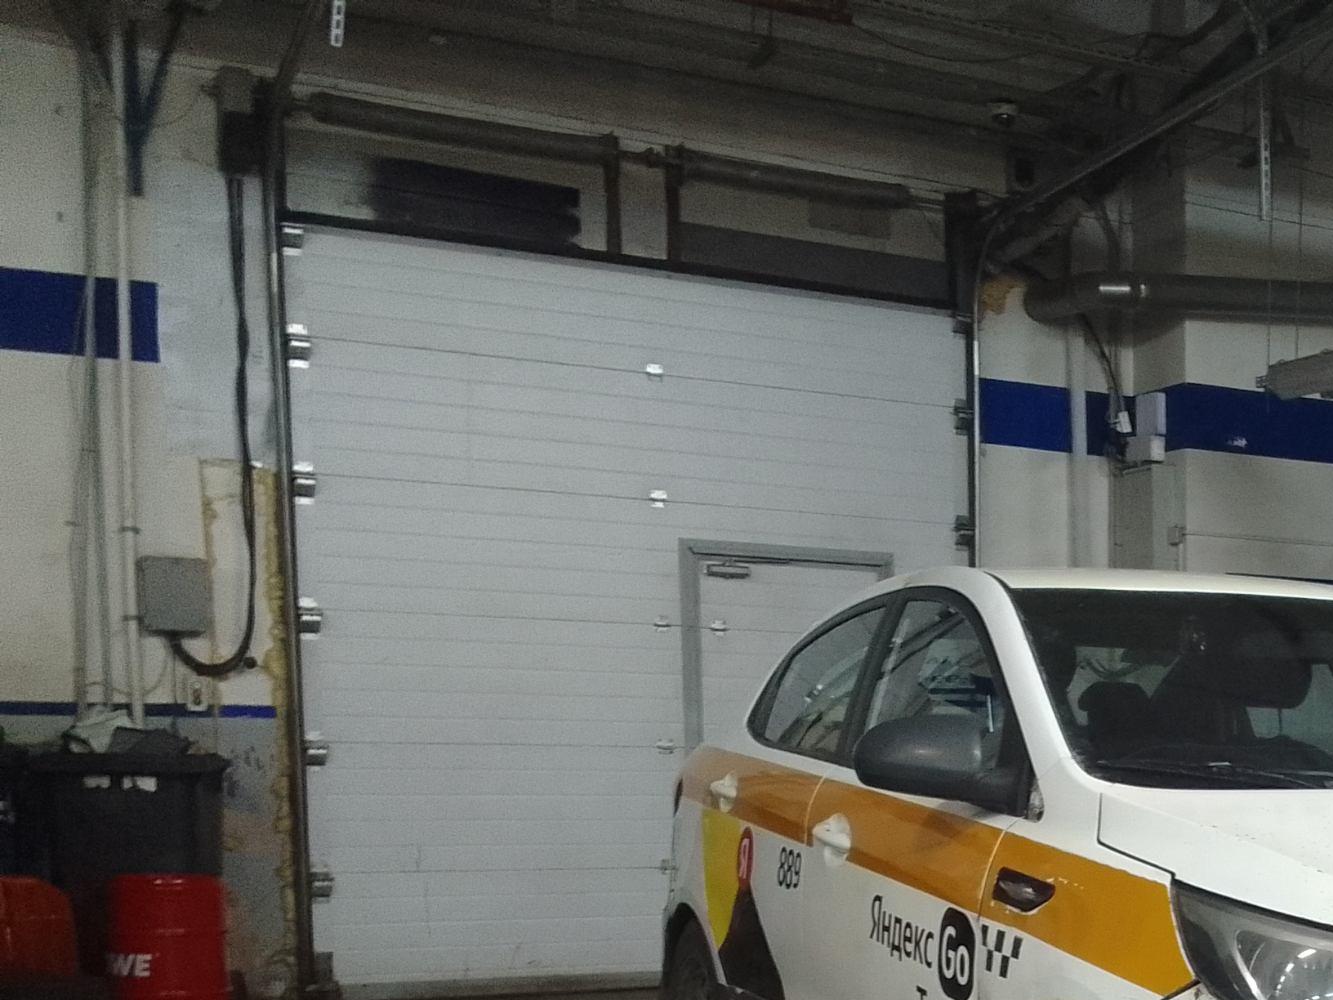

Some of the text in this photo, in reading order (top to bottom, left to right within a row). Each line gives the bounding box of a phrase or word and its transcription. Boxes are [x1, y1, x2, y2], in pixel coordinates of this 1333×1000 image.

[739, 838, 750, 879] Я
[777, 846, 802, 890] 889
[869, 894, 970, 986] Яндекс Go
